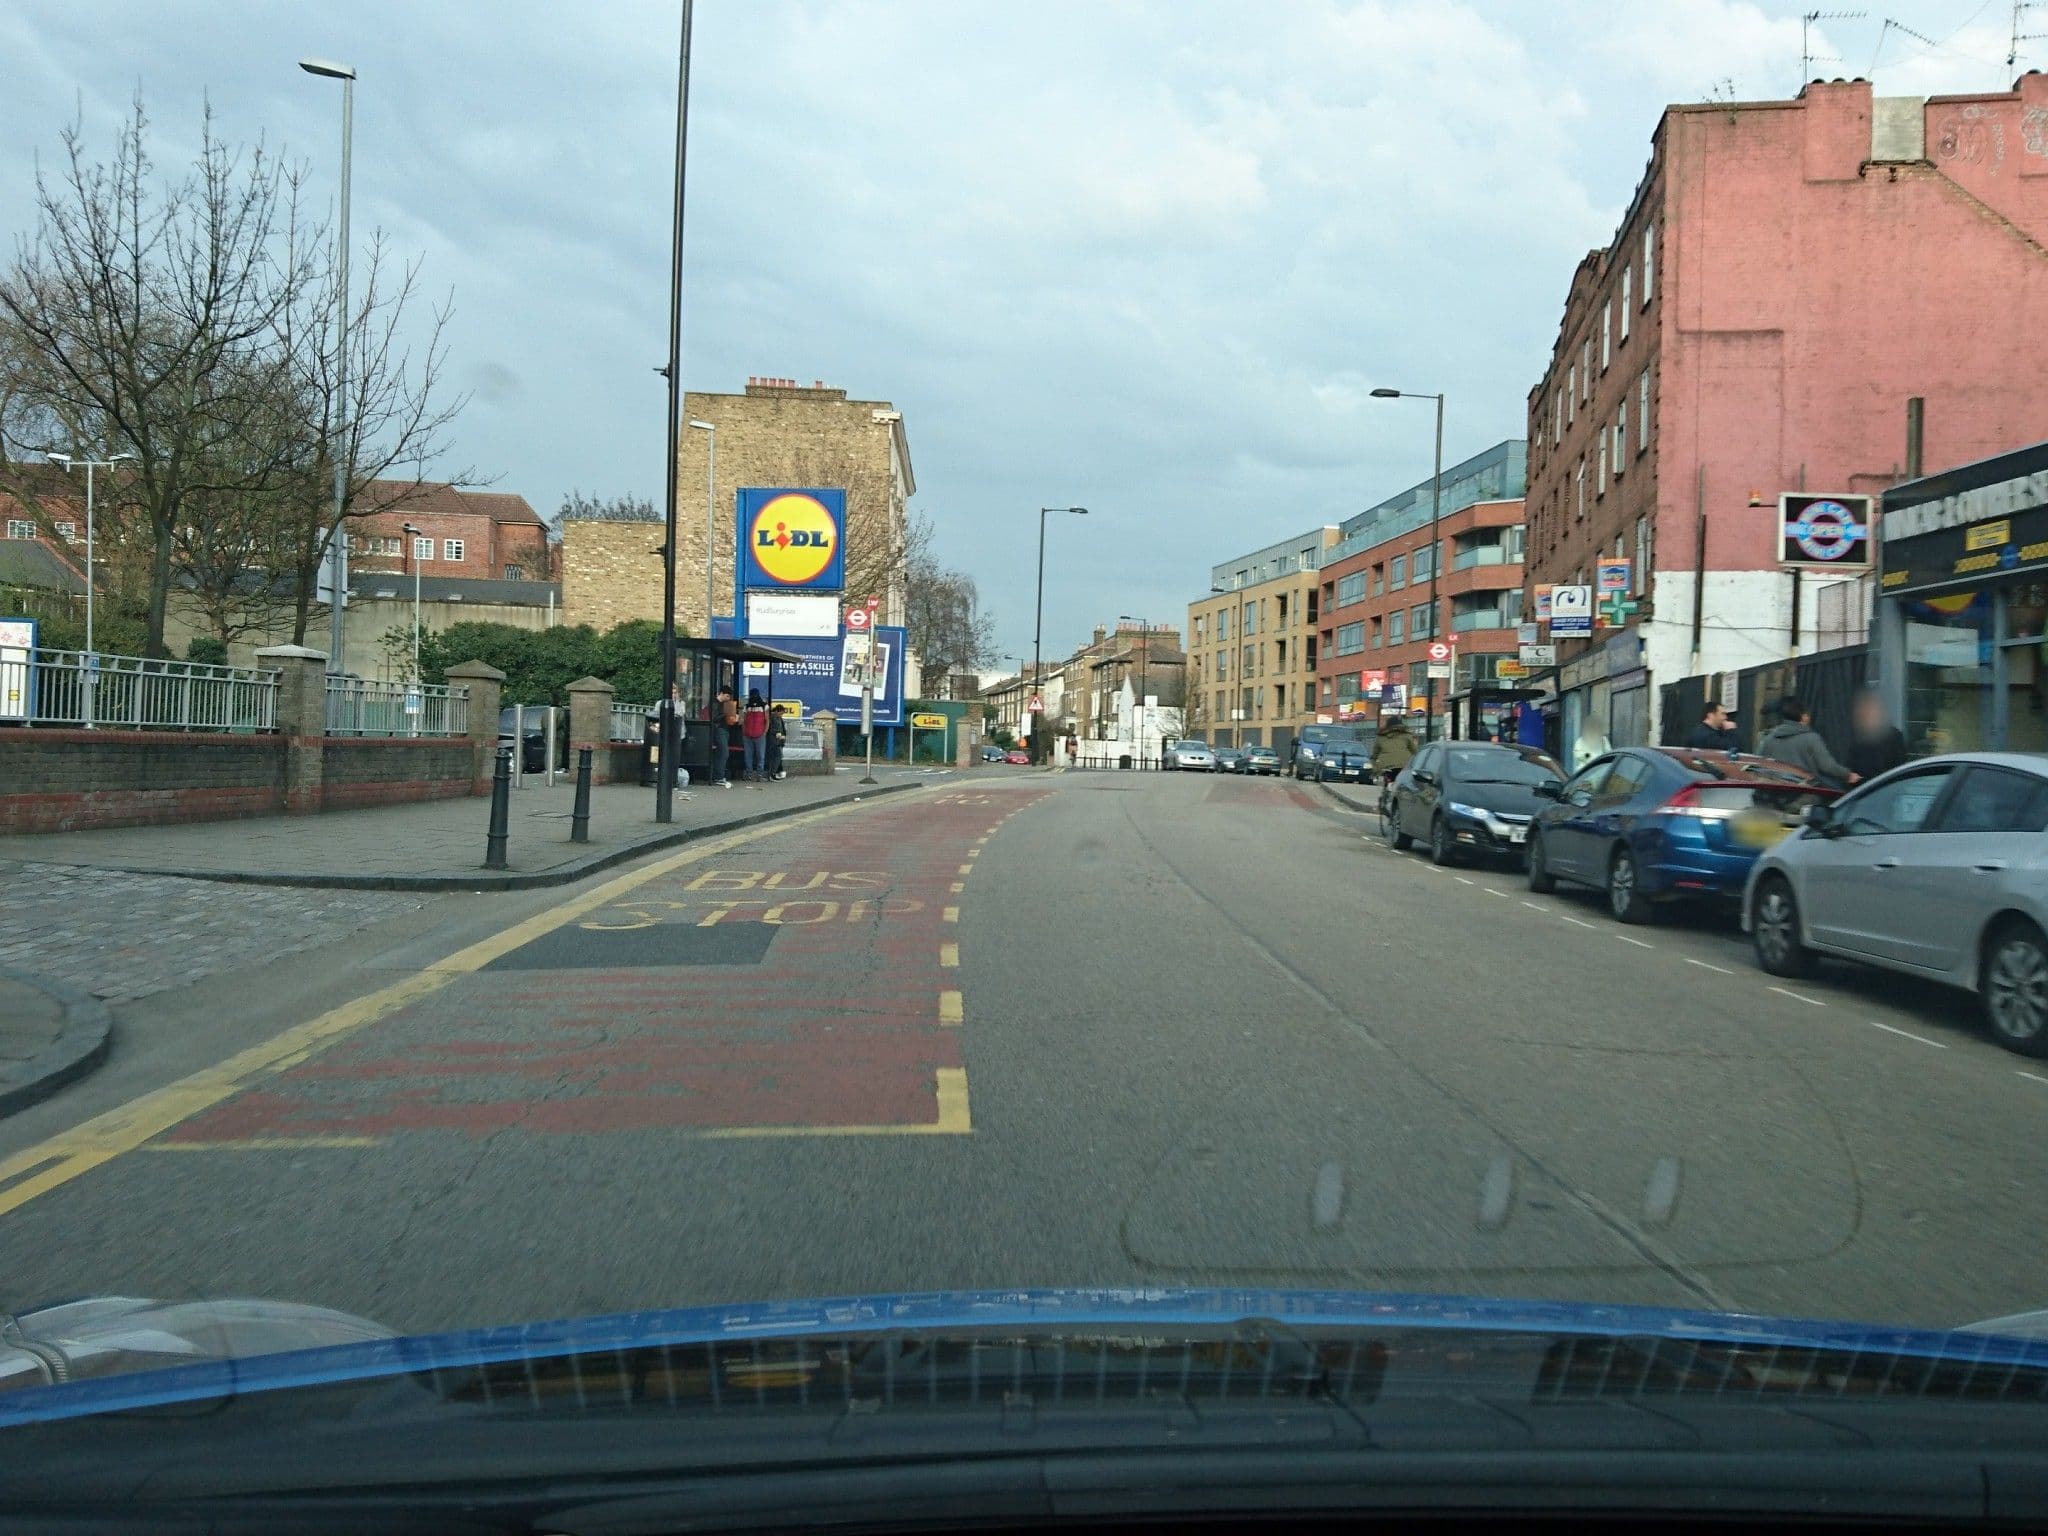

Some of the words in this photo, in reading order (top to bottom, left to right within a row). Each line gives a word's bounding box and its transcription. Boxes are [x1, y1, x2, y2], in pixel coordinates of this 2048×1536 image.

[778, 669, 835, 677] PROGRAMME
[807, 663, 835, 671] SKILLS
[683, 870, 888, 891] BUS
[578, 900, 926, 931] STOP
